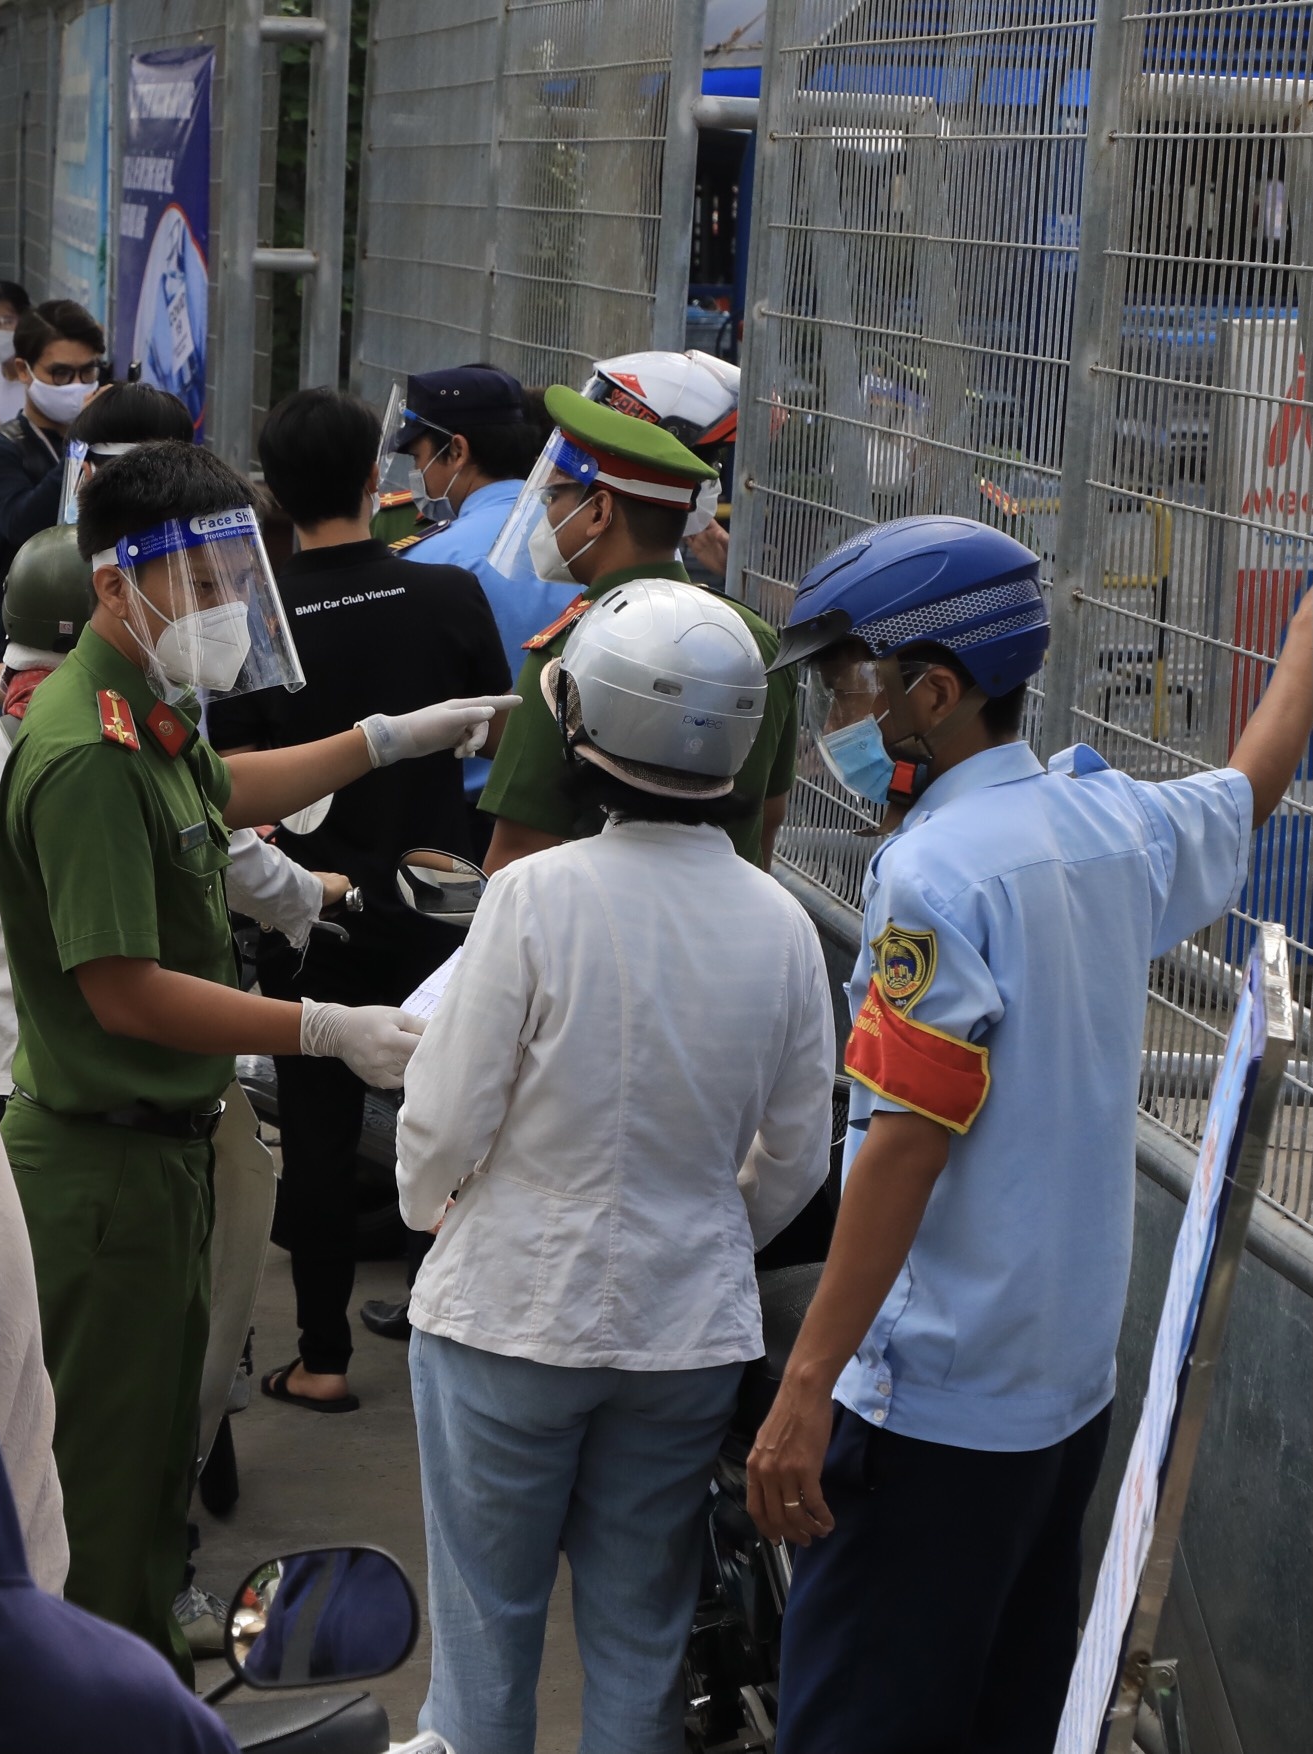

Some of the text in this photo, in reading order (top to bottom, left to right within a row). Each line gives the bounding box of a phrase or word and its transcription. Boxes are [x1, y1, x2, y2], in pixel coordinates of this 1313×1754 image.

[198, 511, 252, 531] Face Shi
[204, 529, 237, 541] Protective
[295, 586, 406, 616] BMW Car Club Vietnam
